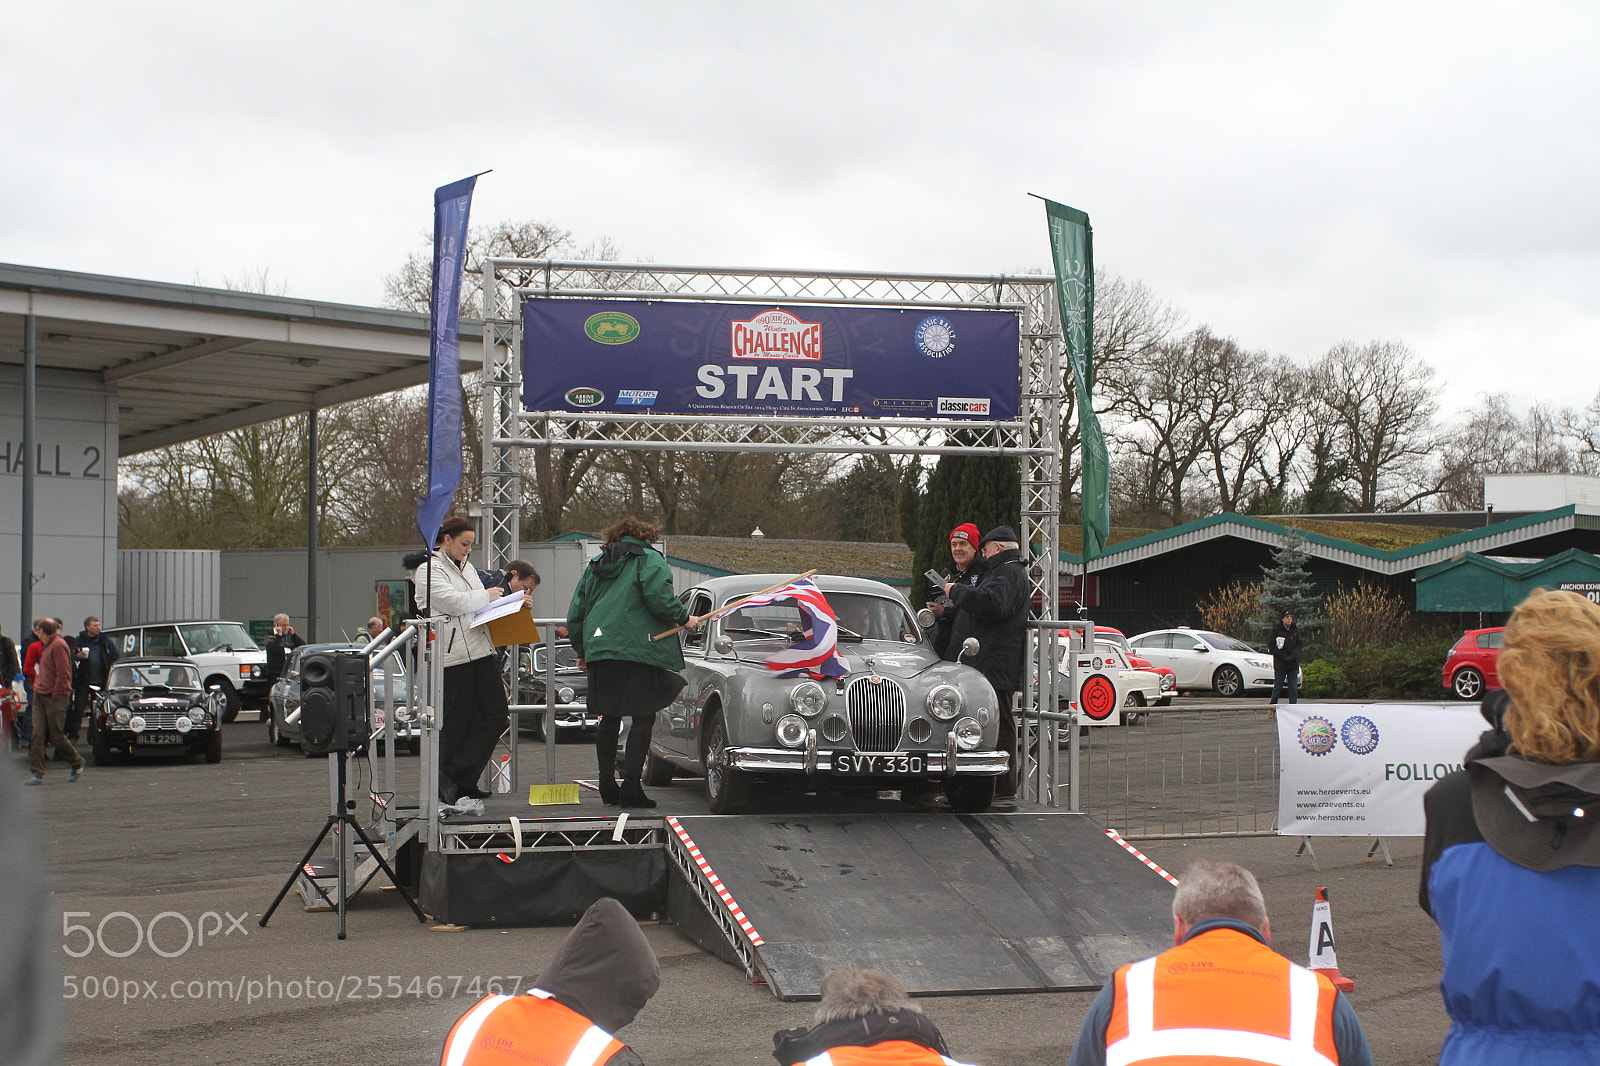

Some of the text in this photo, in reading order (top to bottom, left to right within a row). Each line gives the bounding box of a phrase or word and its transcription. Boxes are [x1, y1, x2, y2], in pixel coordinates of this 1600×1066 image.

[763, 324, 787, 332] Winter
[917, 318, 957, 339] CLASSIC RALLY
[734, 323, 820, 359] CHALLENGE
[918, 342, 956, 358] ASSOCIATION
[695, 364, 853, 402] START
[620, 390, 656, 398] MOTORS
[83, 446, 100, 477] 2
[123, 634, 136, 653] 19
[138, 735, 157, 743] BLE
[837, 756, 922, 773] SVY 330
[1296, 788, 1371, 796] www.heroevents.eu
[1296, 801, 1366, 809] www.craevents.eu
[1295, 813, 1366, 822] www.herostore.eu
[1316, 921, 1336, 956] A
[497, 1038, 514, 1048] LIVE
